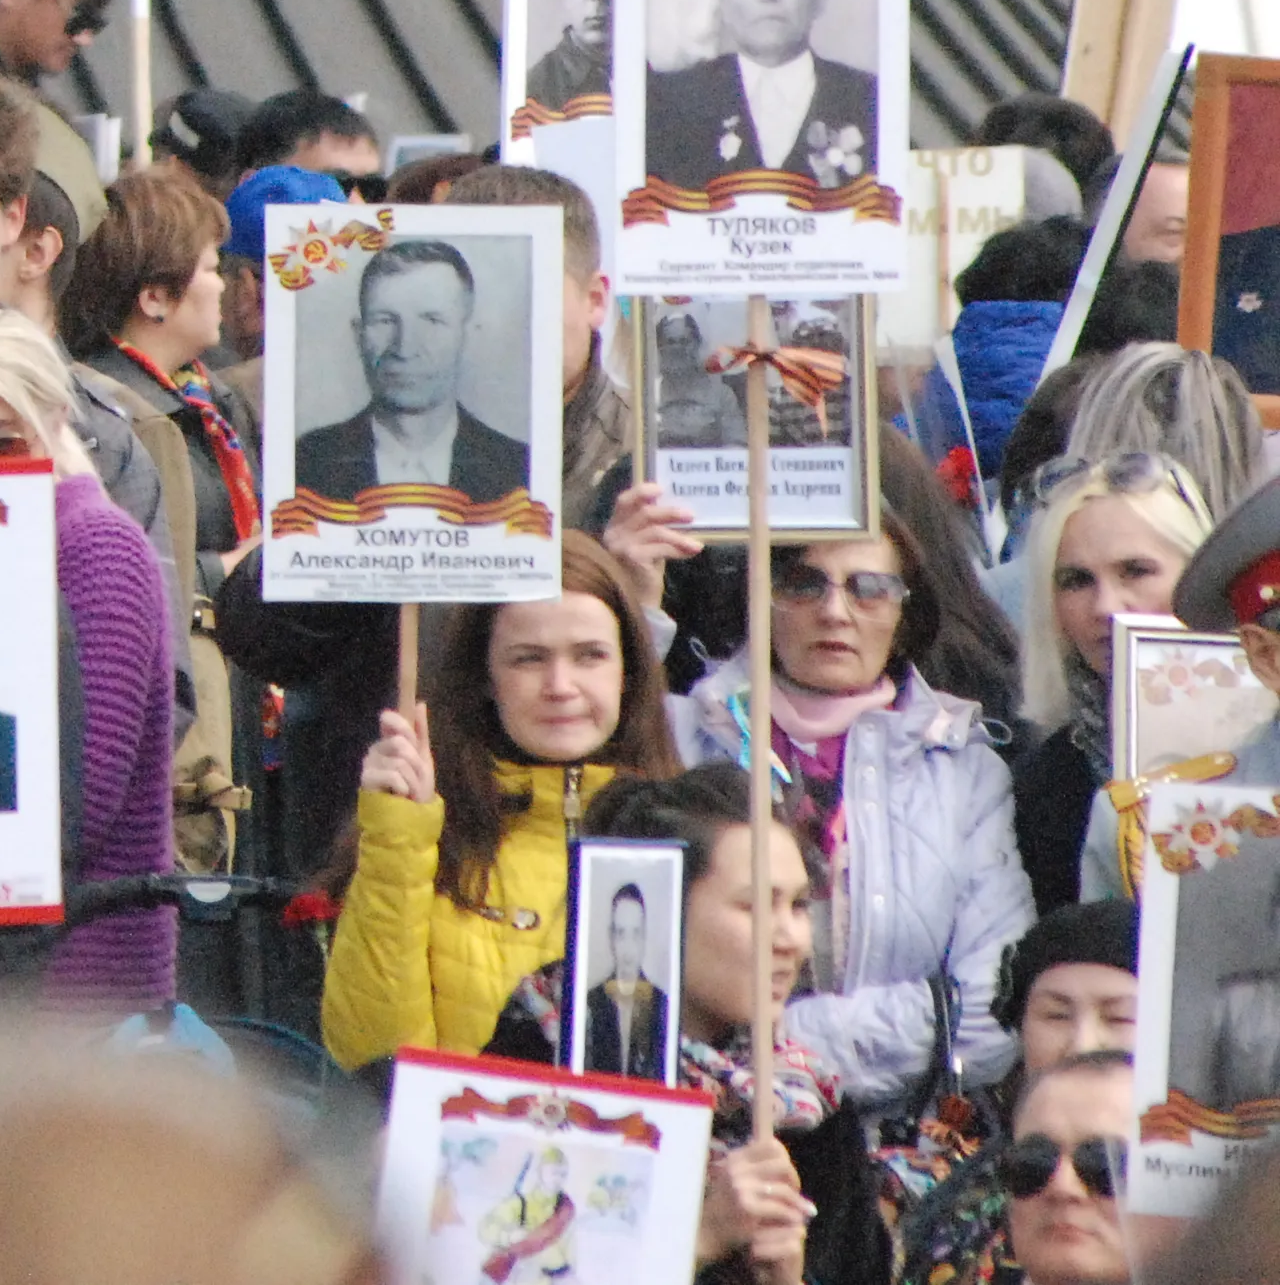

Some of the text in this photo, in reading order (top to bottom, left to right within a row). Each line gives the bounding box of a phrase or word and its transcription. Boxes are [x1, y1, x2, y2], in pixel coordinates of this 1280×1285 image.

[707, 216, 818, 236] ТУЛЯКОВ
[729, 238, 794, 258] Кузек
[715, 454, 749, 472] Васи
[354, 528, 470, 548] ХОМУТОВ
[289, 550, 535, 572] Александр Иванович
